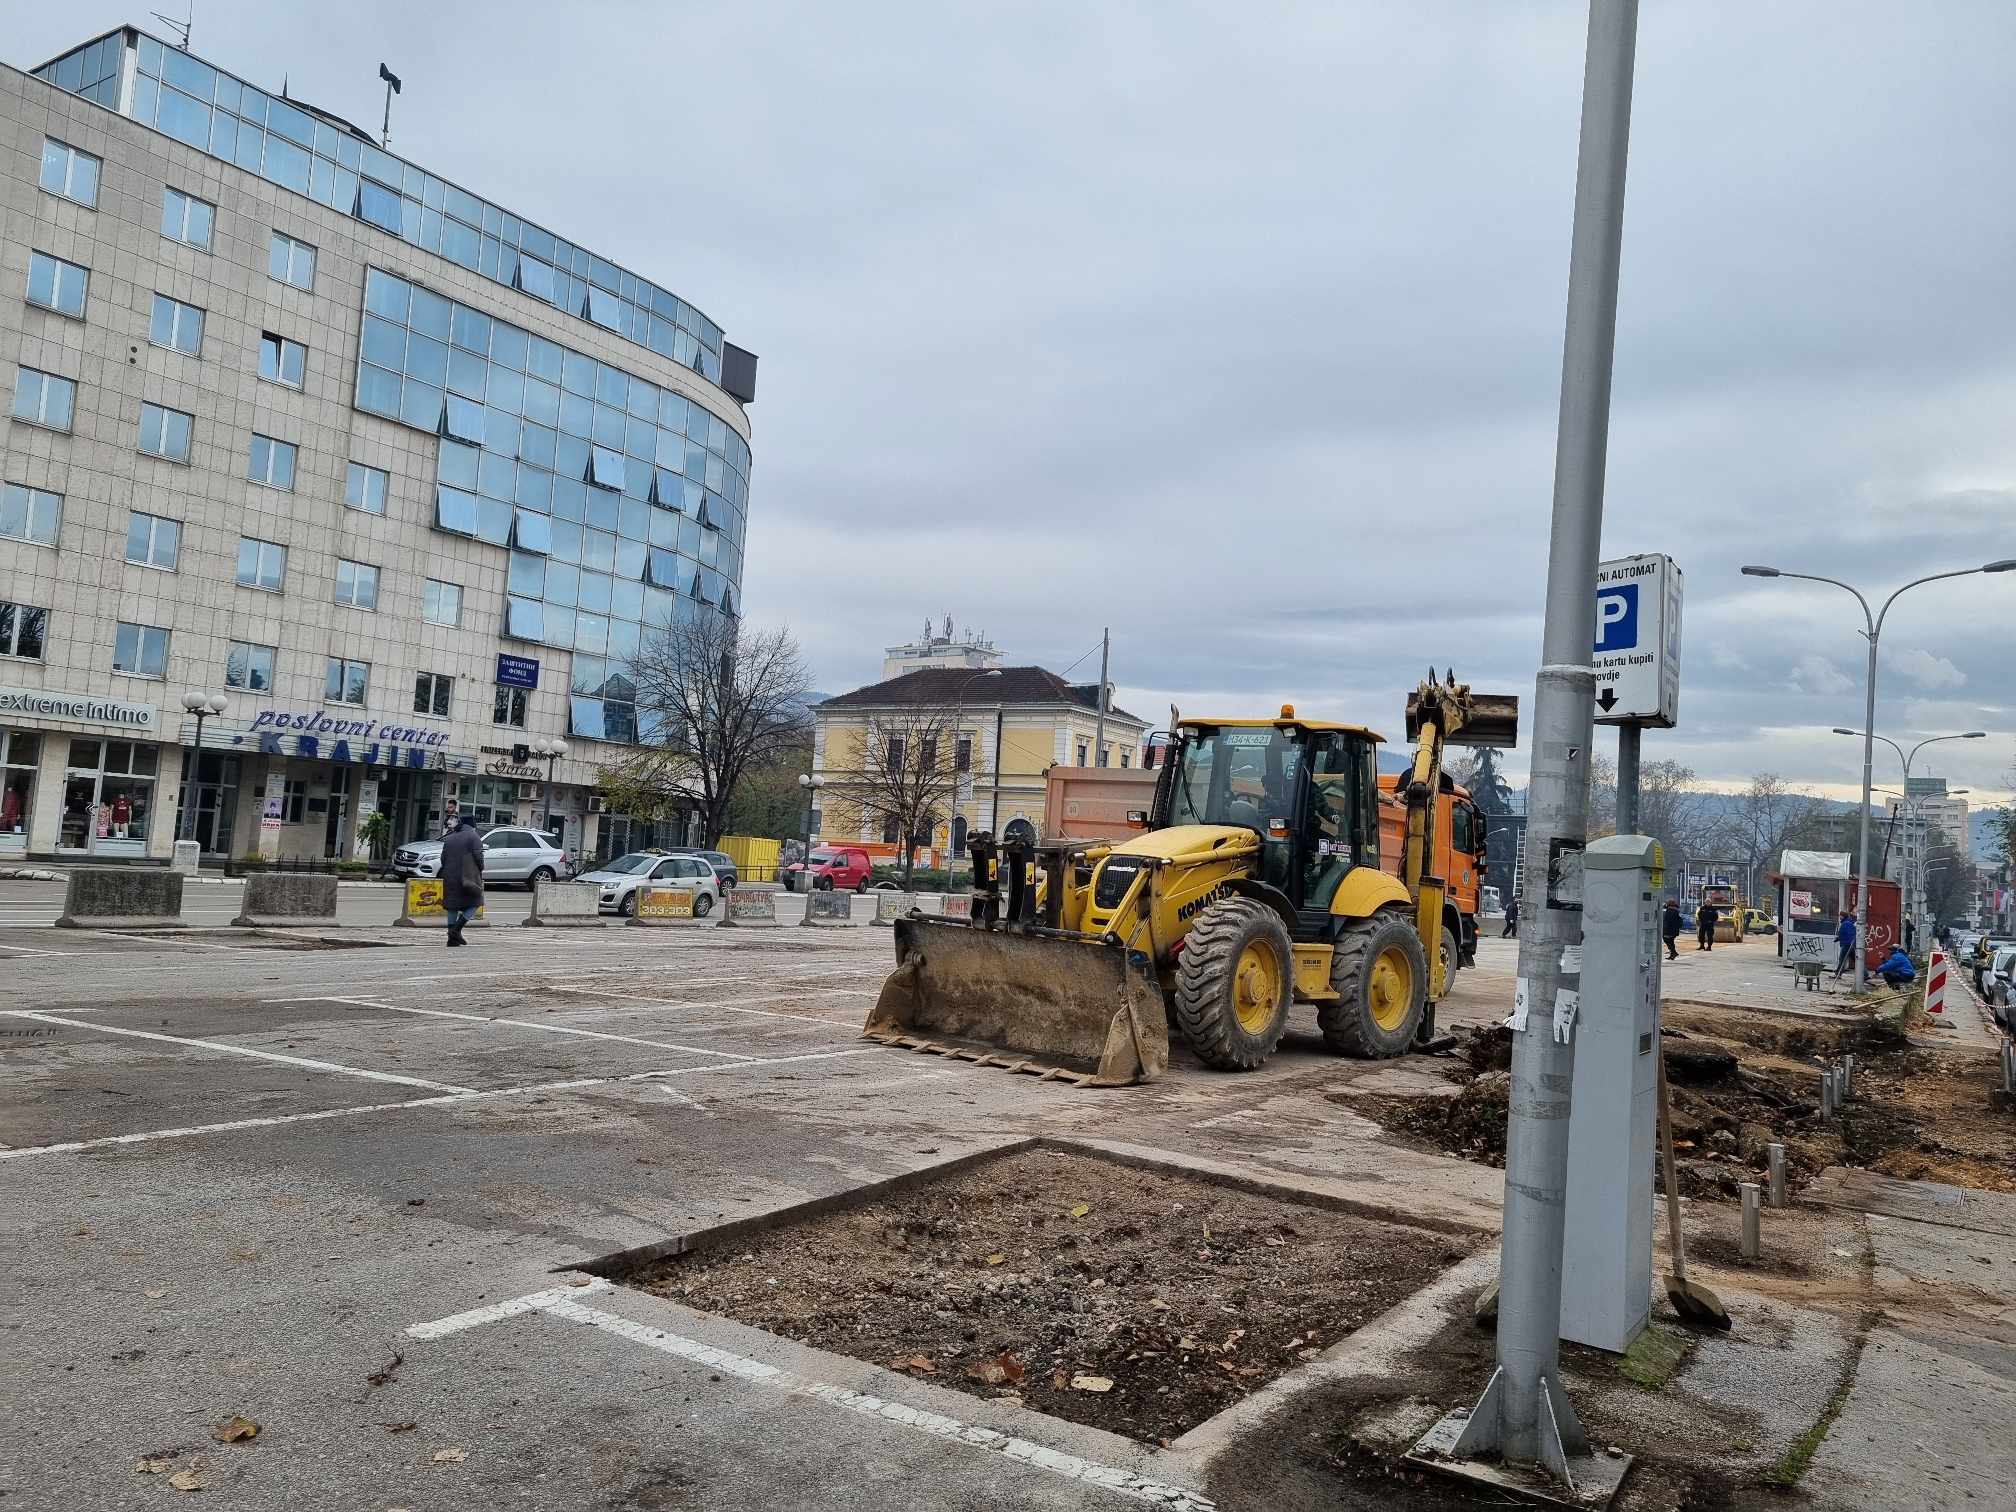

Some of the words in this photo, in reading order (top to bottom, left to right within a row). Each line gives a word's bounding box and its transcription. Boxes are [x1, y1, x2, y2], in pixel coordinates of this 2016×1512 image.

[1611, 563, 1657, 581] AUTOMAT
[1596, 594, 1628, 644] P
[1603, 657, 1626, 668] kartu
[1628, 652, 1654, 667] kupiti
[0, 692, 85, 718] extreme
[87, 701, 151, 724] intimo
[249, 710, 378, 737] poslovni
[379, 723, 451, 746] centar
[259, 731, 447, 771] KRAJINA
[485, 757, 543, 778] Goran
